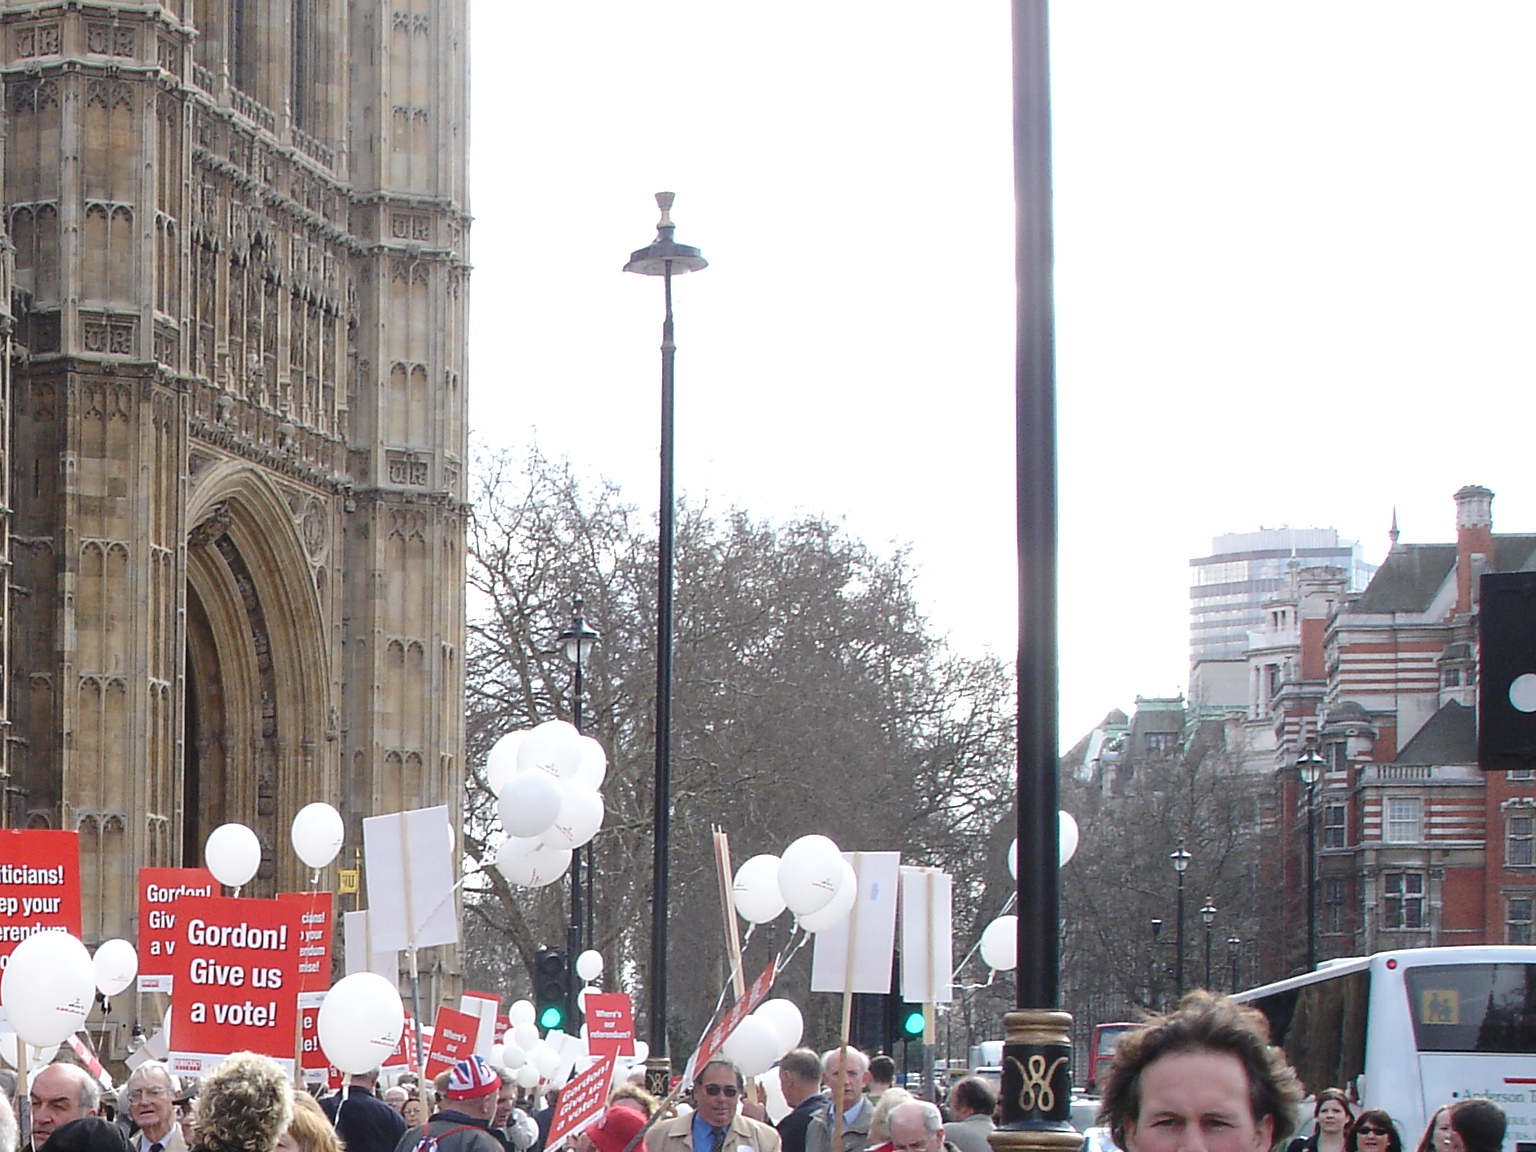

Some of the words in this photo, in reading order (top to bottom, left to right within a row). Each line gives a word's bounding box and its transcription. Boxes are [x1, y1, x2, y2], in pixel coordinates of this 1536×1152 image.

[22, 897, 61, 917] your
[149, 910, 175, 929] Giv
[188, 919, 287, 951] Gordon!
[190, 958, 245, 987] Give
[252, 967, 283, 989] us
[191, 1003, 206, 1023] a
[214, 1001, 277, 1027] vote!
